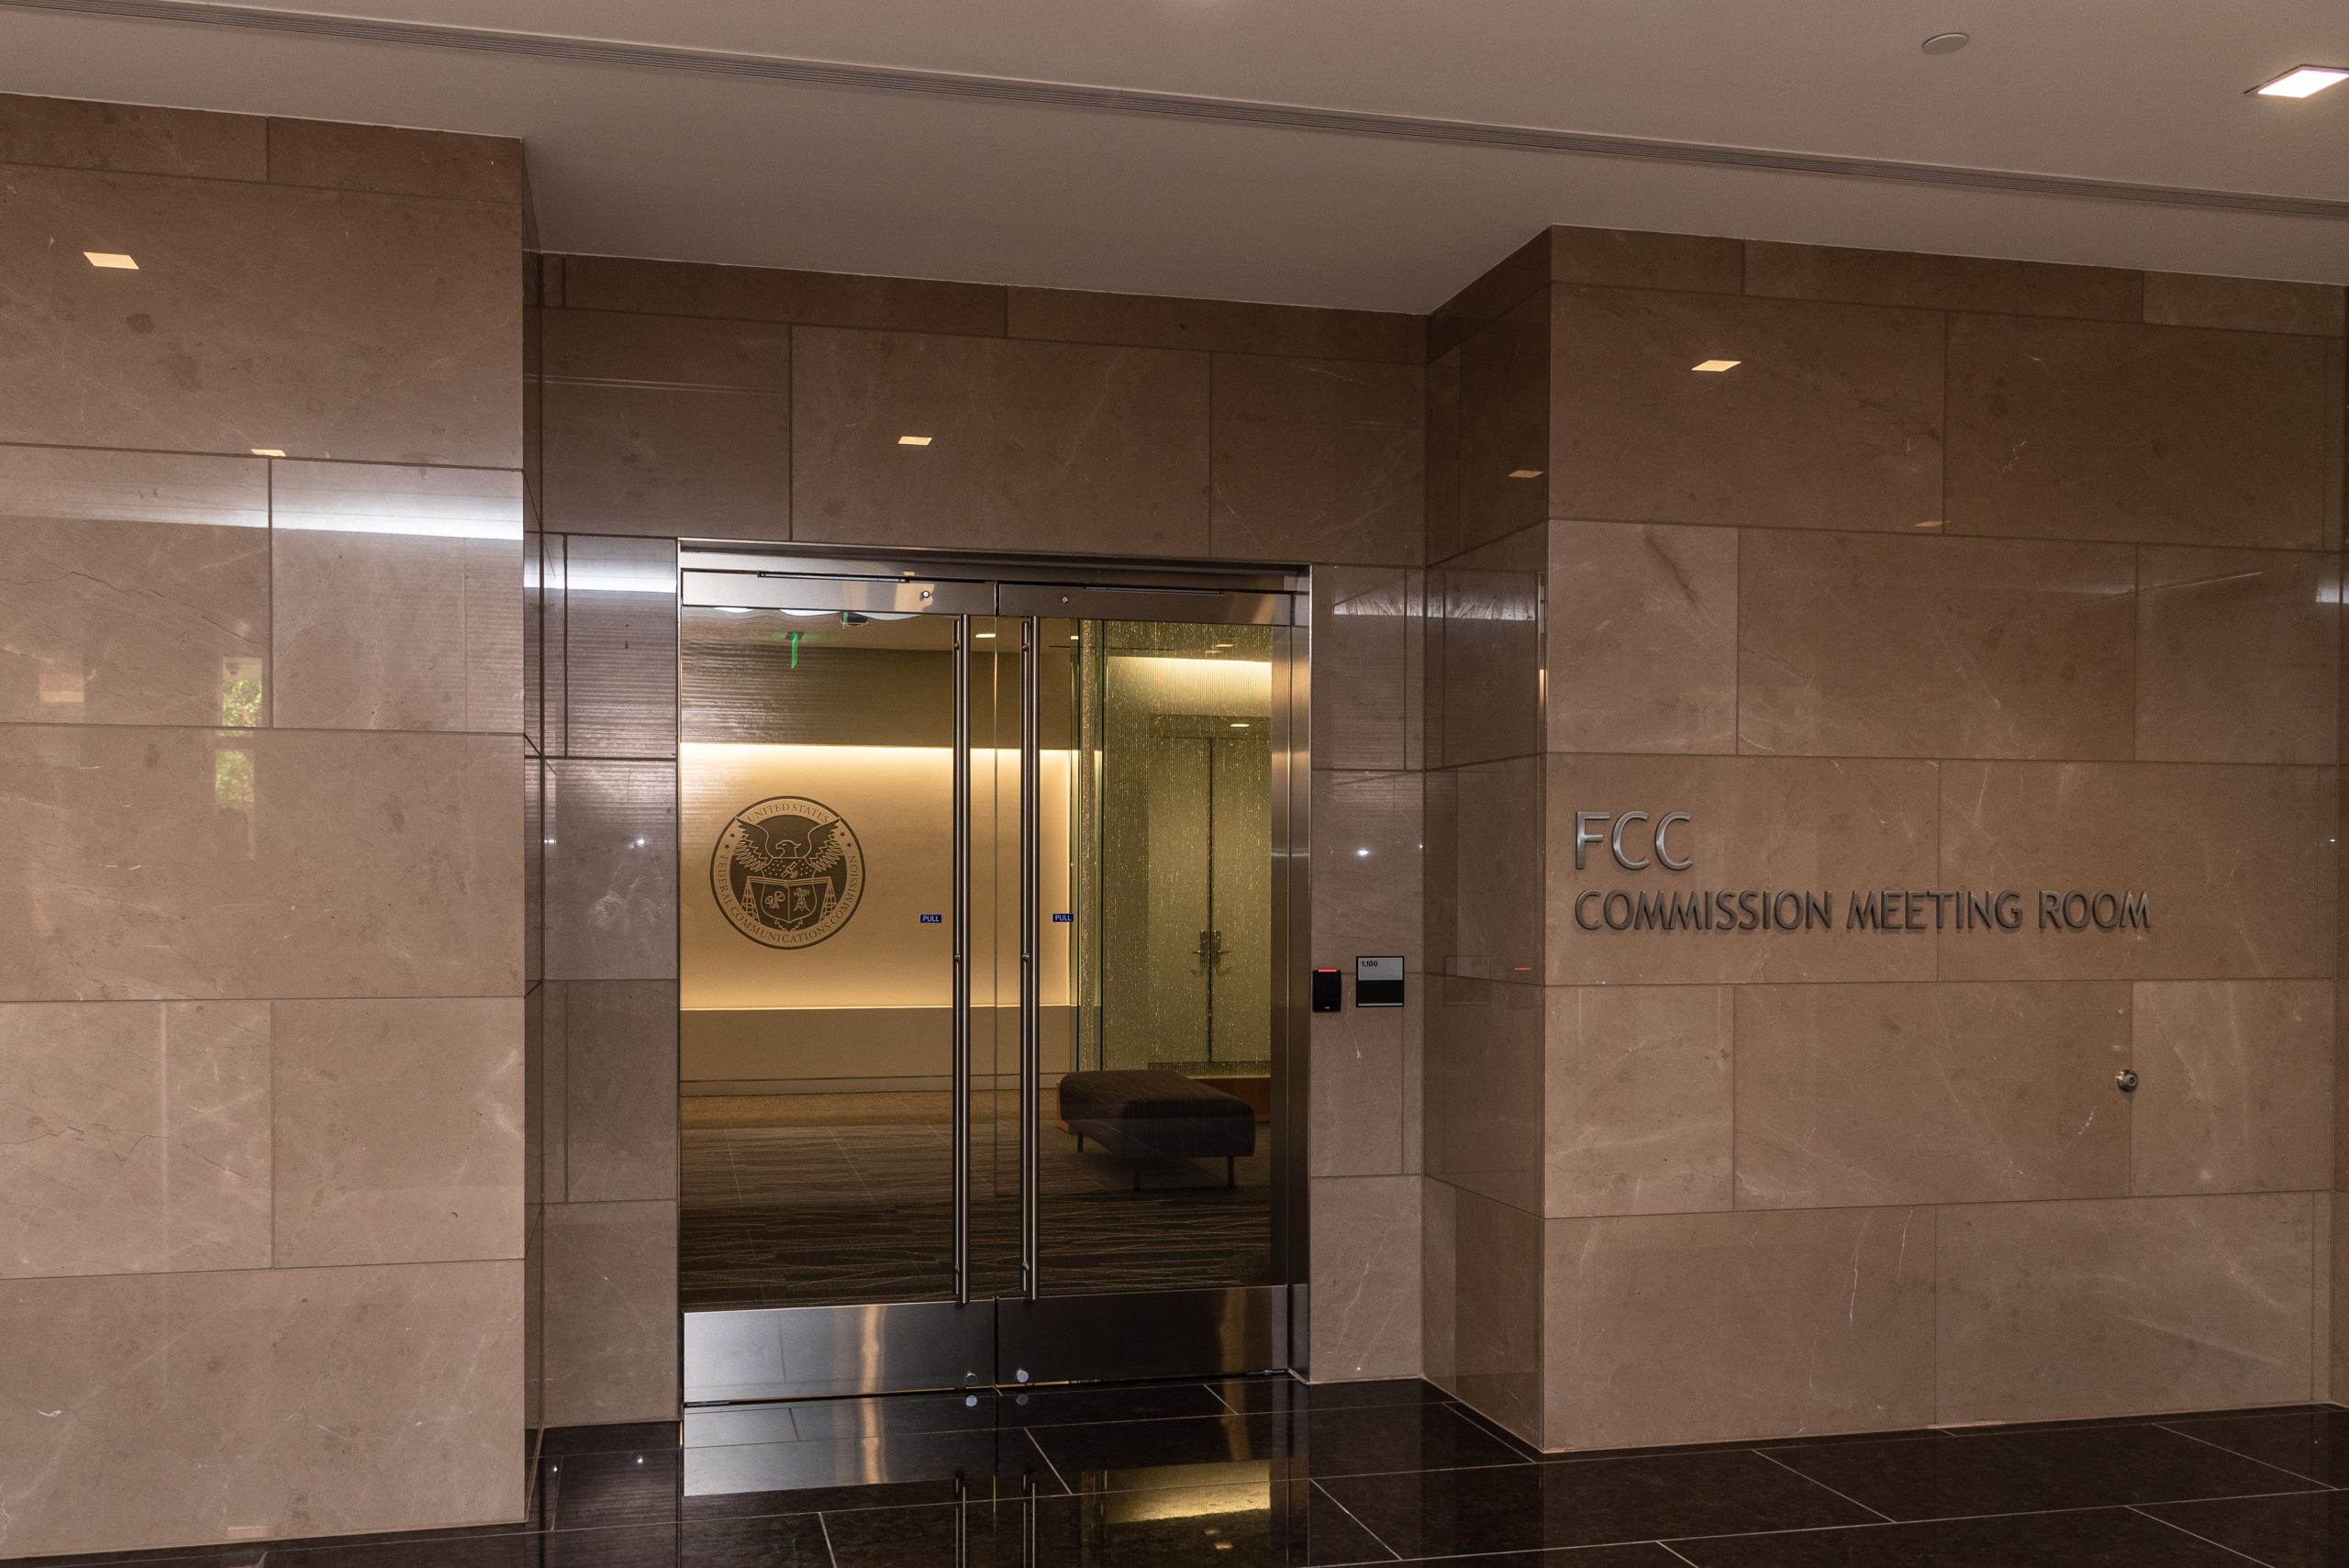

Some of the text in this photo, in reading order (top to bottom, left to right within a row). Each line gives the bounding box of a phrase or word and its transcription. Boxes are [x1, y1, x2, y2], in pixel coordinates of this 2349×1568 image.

[747, 803, 829, 823] UNITED STATES
[1575, 810, 1694, 872] FCC
[718, 855, 859, 943] FEDERAL COMMUNICATIONS COMMISSION
[1575, 889, 2152, 930] COMMISSION MEETING ROOM
